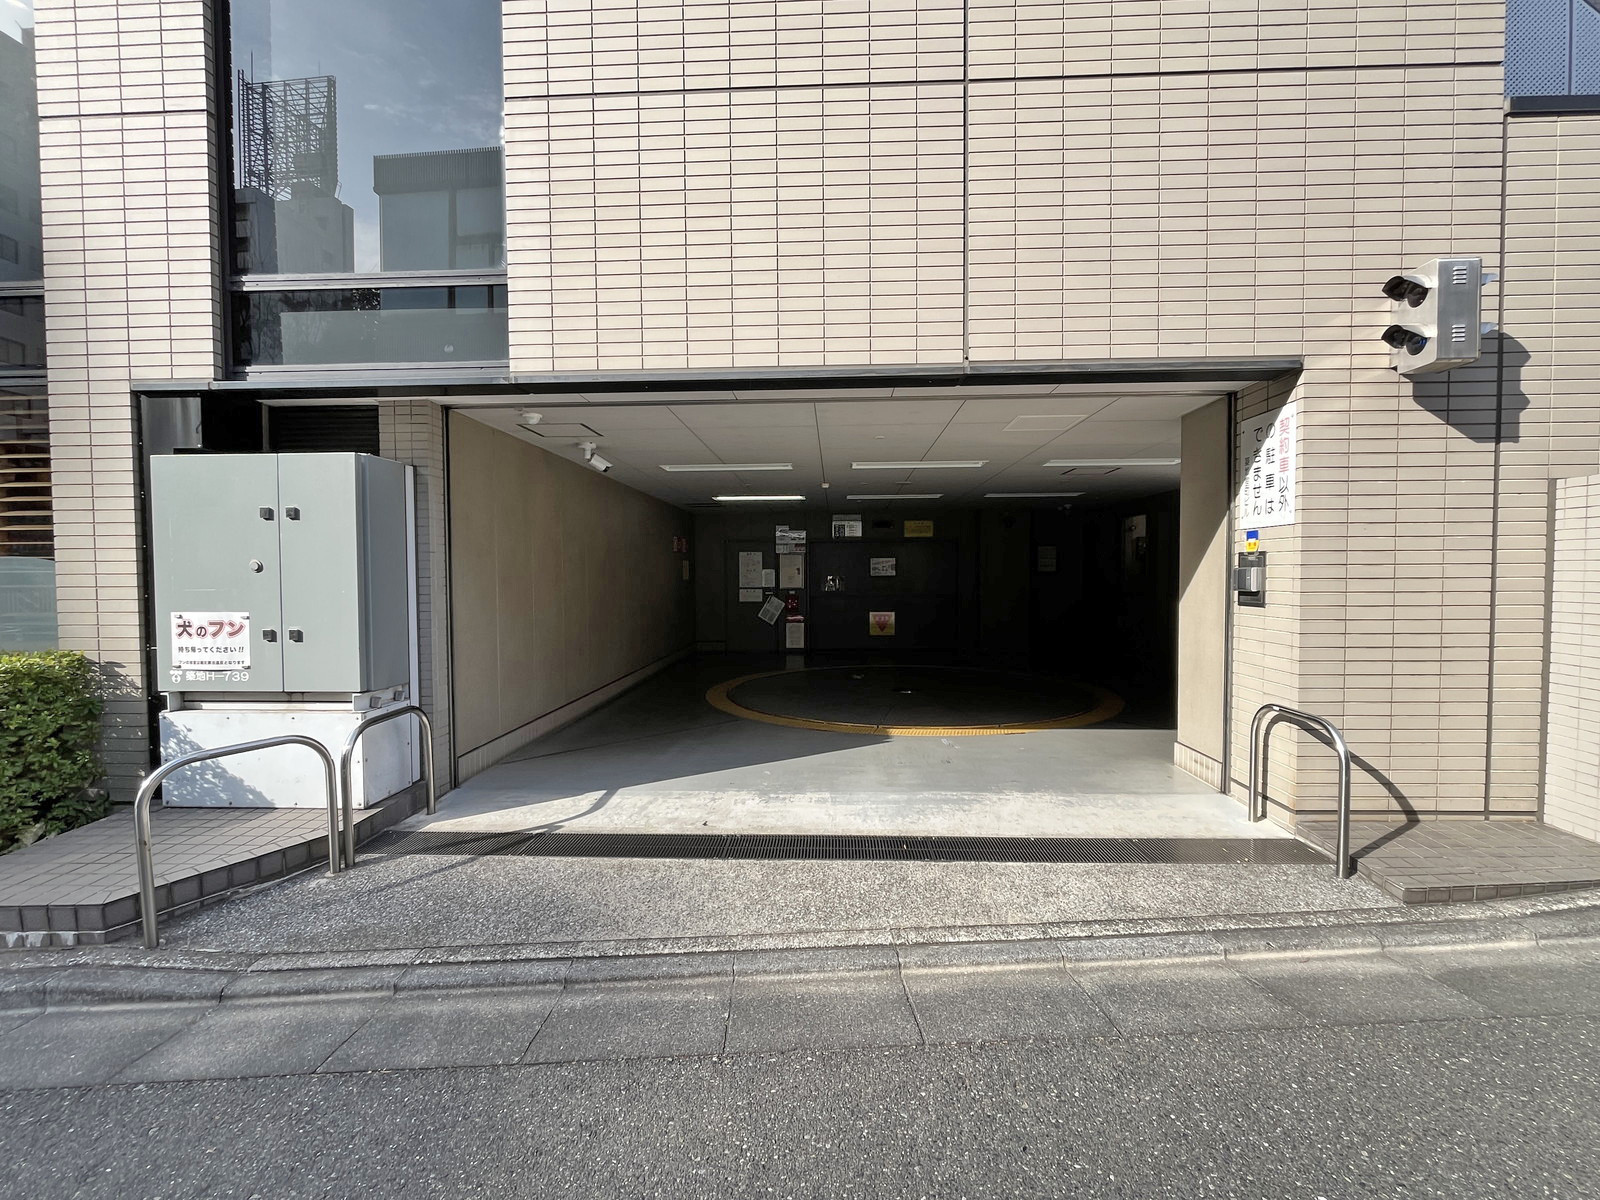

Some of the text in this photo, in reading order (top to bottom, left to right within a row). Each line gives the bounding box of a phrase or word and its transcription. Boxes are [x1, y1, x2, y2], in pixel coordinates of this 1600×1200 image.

[1253, 426, 1263, 515] できません
[1265, 423, 1276, 514] の駐車は
[1279, 417, 1290, 512] 契約車以外
[176, 619, 245, 639] 犬のフン
